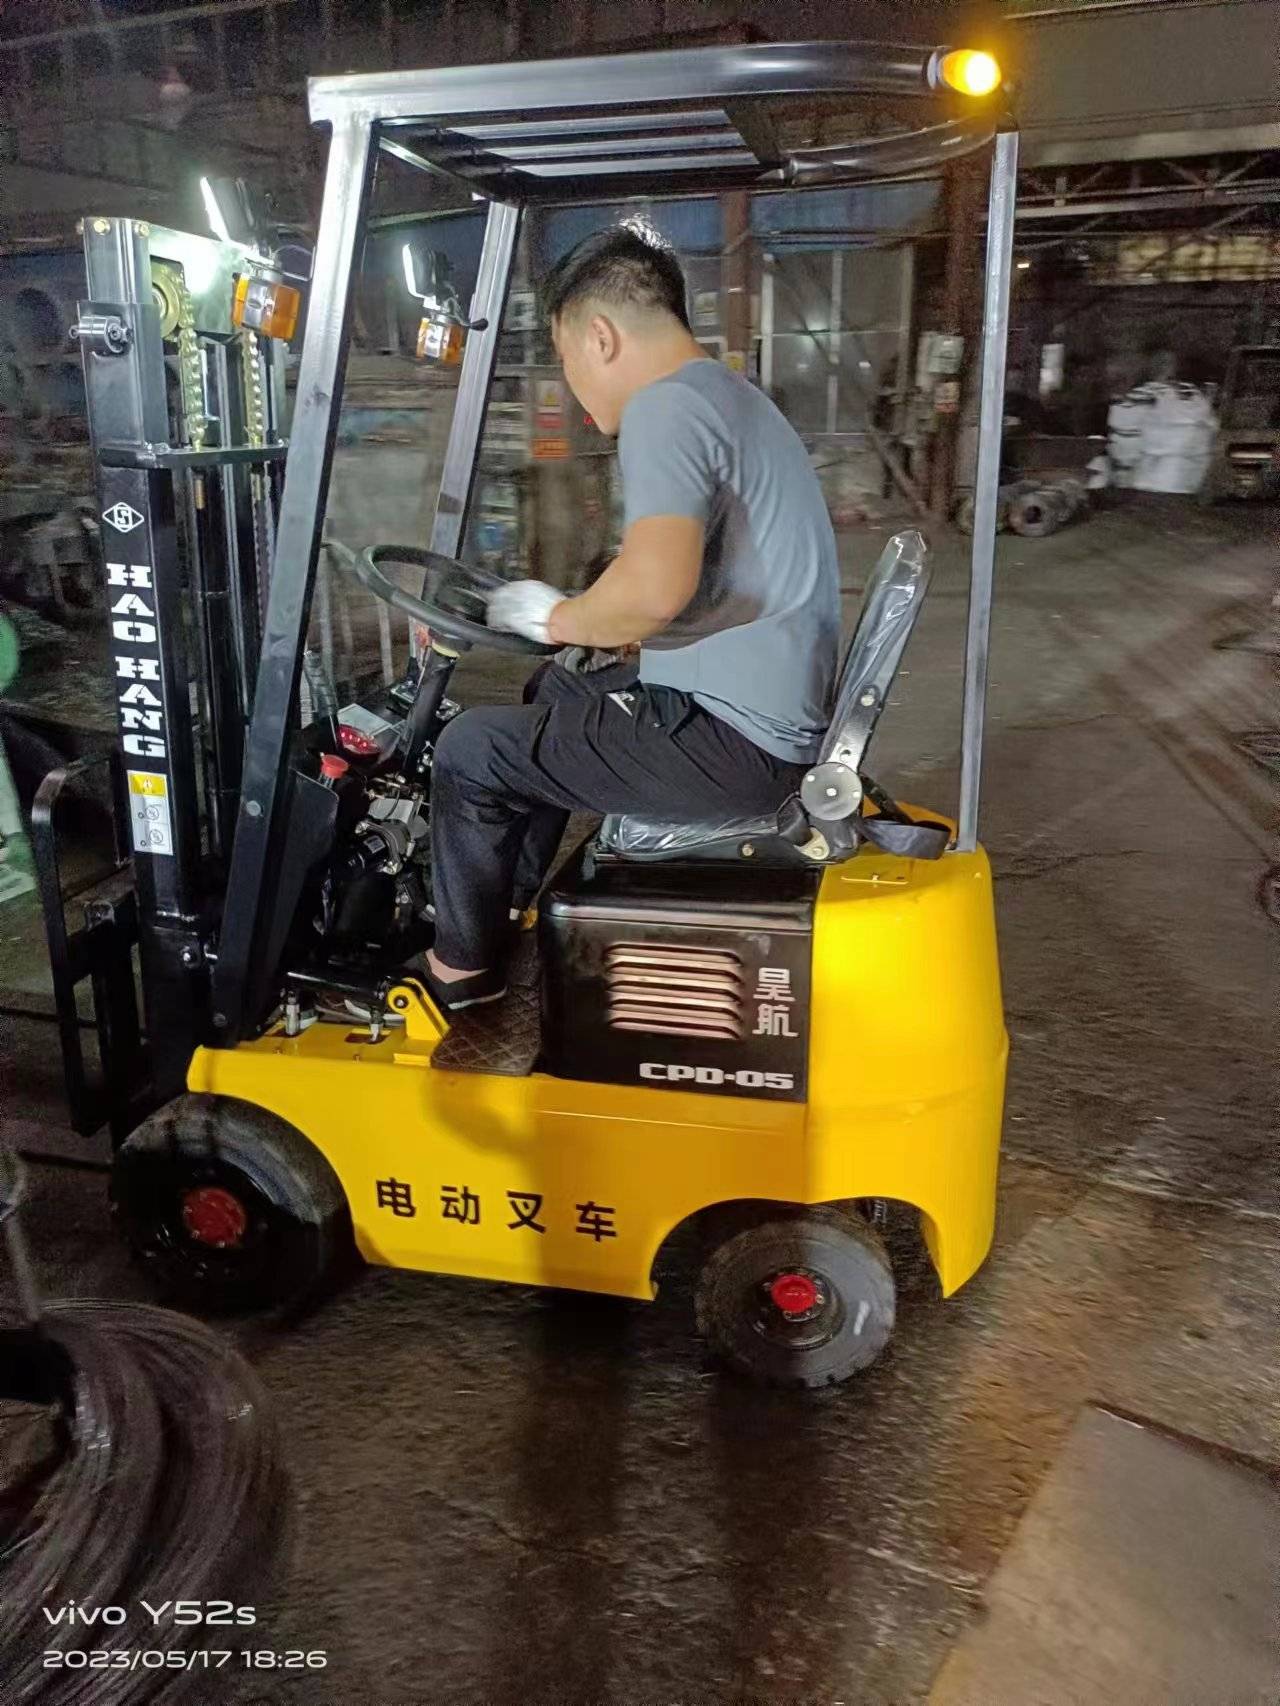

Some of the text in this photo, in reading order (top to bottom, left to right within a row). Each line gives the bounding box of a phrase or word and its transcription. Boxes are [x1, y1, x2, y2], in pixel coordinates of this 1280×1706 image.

[106, 562, 166, 758] HAO HANG
[752, 967, 799, 1038] 昊航
[639, 1062, 794, 1090] CPD-05
[375, 1177, 618, 1242] 电动叉车
